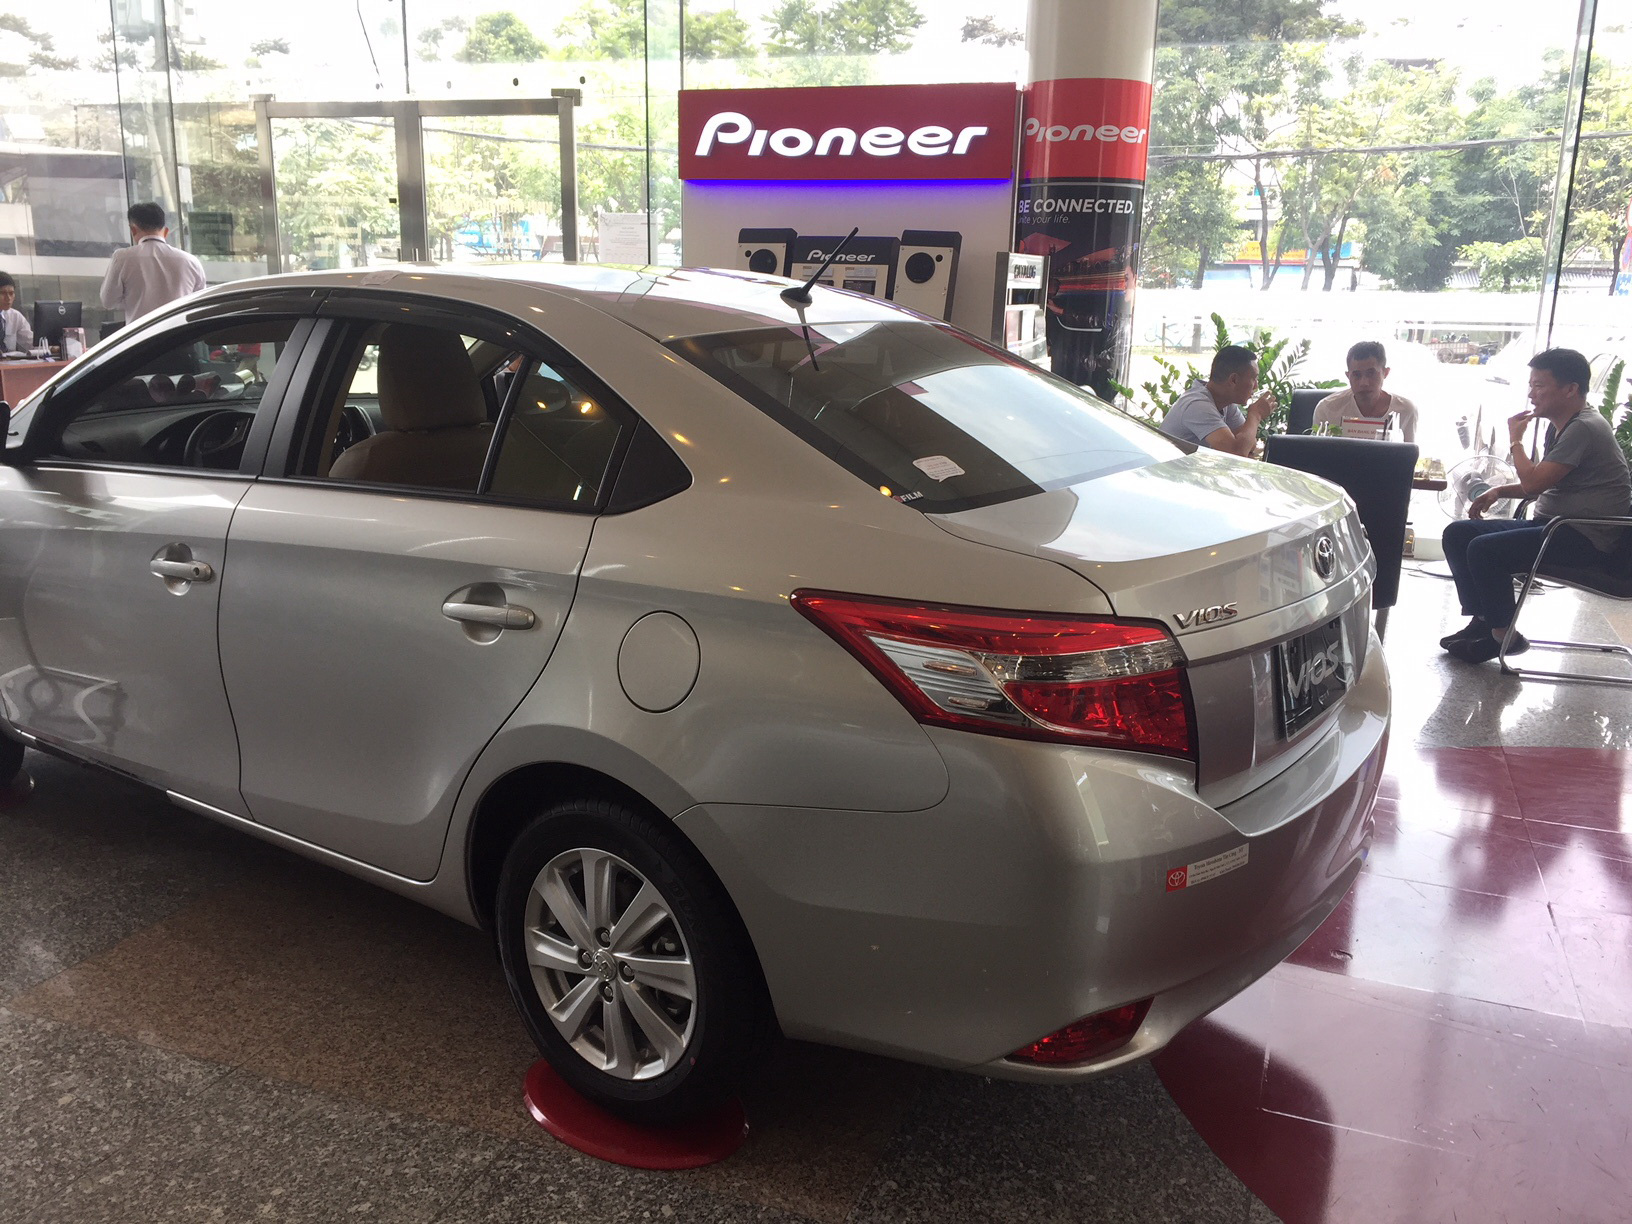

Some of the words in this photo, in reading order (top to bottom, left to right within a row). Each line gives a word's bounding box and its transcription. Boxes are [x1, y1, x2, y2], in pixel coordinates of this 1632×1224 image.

[695, 111, 989, 157] Pioneer
[1025, 117, 1147, 144] Pioneer
[1018, 199, 1031, 214] BE
[1033, 198, 1135, 215] CONNECTED.
[1032, 216, 1051, 225] your
[1054, 213, 1070, 224] life.
[900, 491, 924, 502] FILM
